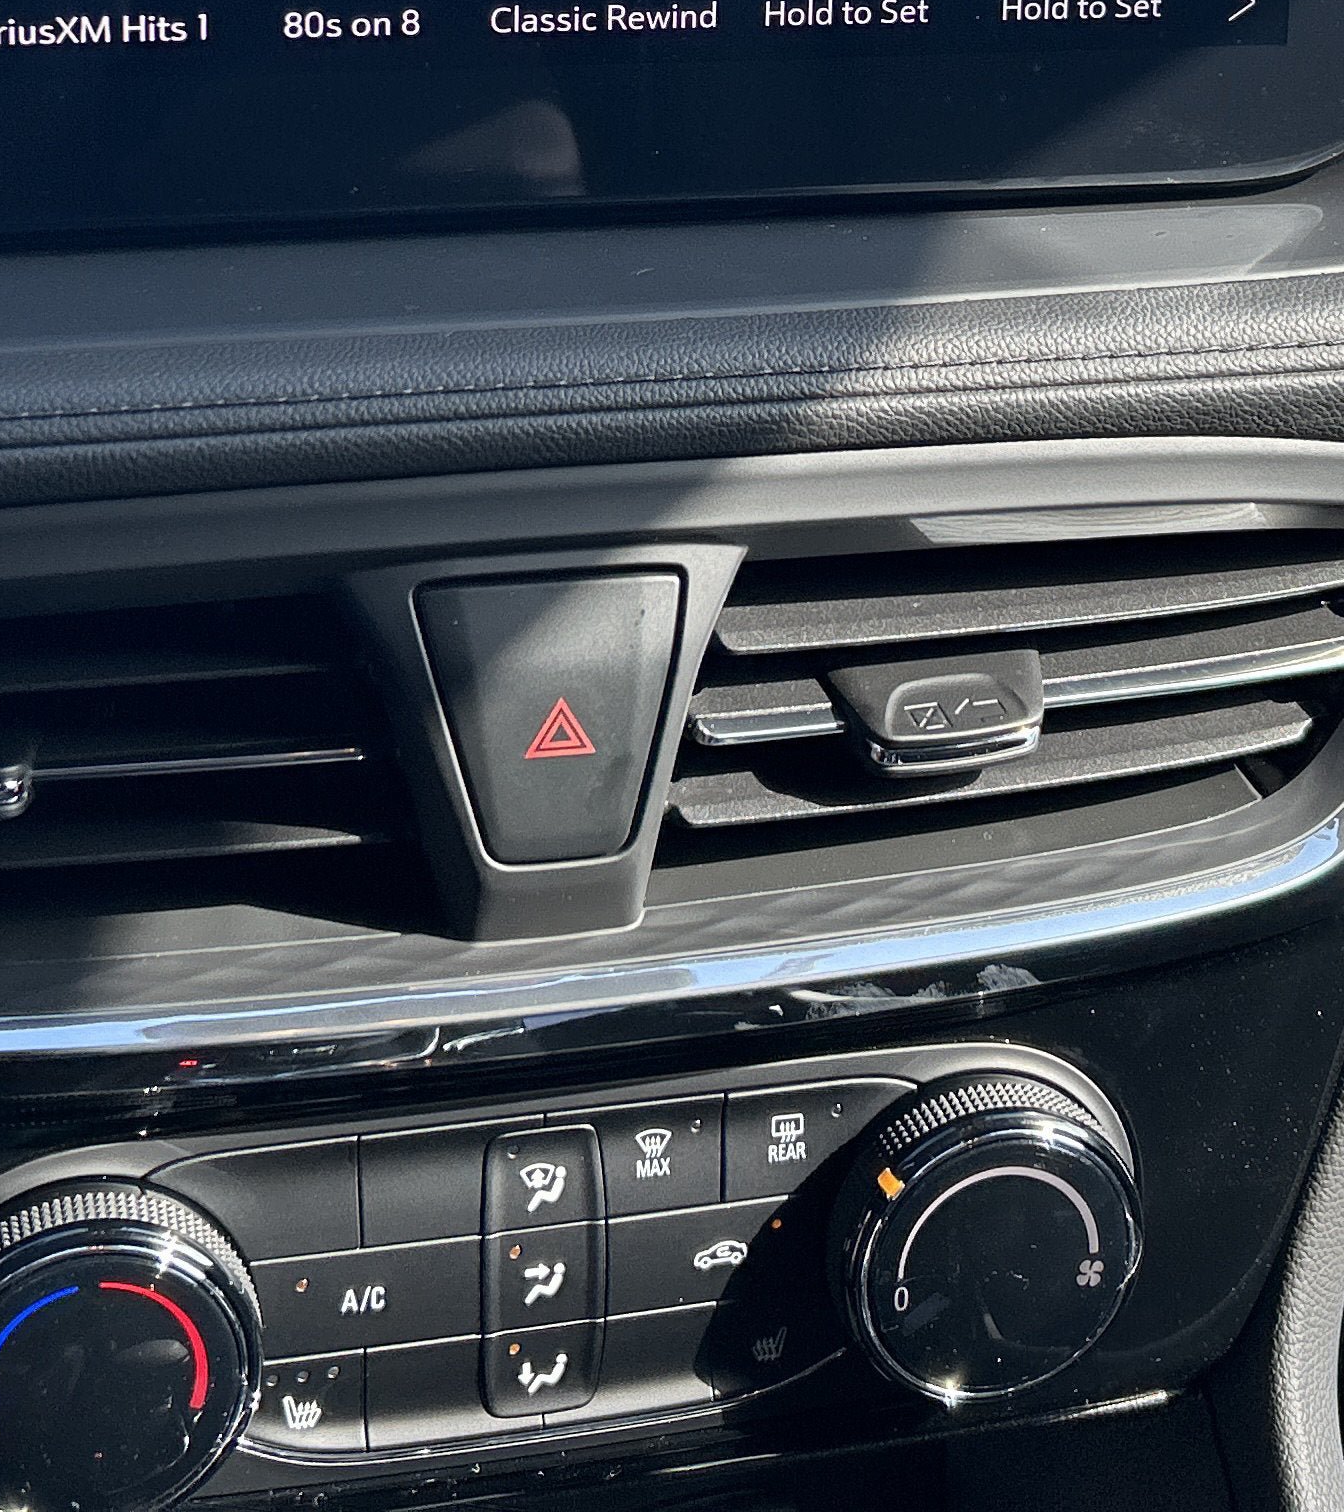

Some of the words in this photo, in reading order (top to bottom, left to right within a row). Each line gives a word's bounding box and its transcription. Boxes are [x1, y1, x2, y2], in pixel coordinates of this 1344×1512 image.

[122, 14, 189, 43] Hits
[197, 12, 209, 42] 1
[282, 10, 343, 40] 80s
[350, 13, 392, 38] on
[400, 8, 421, 37] 8
[489, 5, 598, 34] Classic
[606, 0, 719, 31] Rewind
[841, 1, 872, 26] to
[767, 1141, 807, 1164] REAR
[635, 1156, 671, 1179] MAX
[340, 1285, 387, 1315] A/C
[894, 1285, 909, 1312] 0
